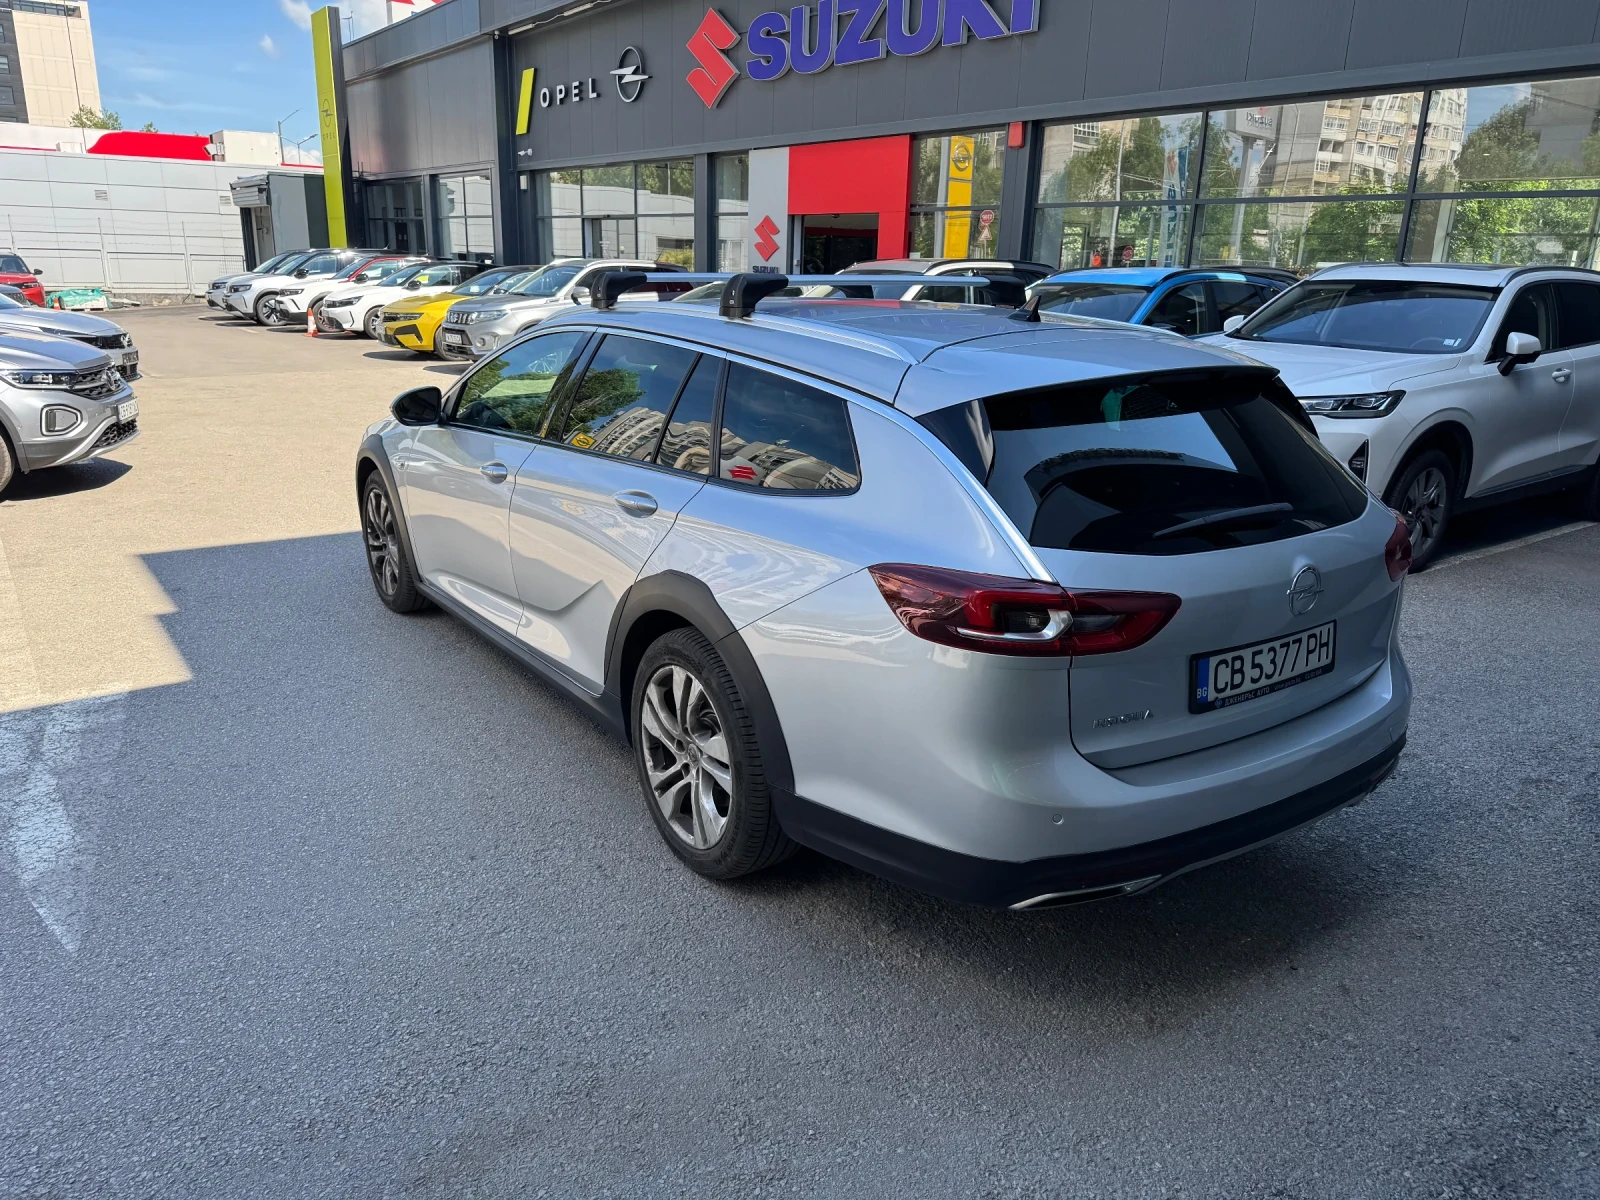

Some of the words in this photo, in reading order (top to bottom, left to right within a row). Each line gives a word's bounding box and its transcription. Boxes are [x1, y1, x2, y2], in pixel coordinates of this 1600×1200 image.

[540, 77, 598, 108] OPEL
[752, 265, 779, 274] SUZUKI
[1213, 654, 1245, 694] CB
[1250, 636, 1303, 684] 5377
[1305, 627, 1331, 667] PH
[1196, 686, 1208, 699] BG
[1256, 687, 1270, 697] АУТО
